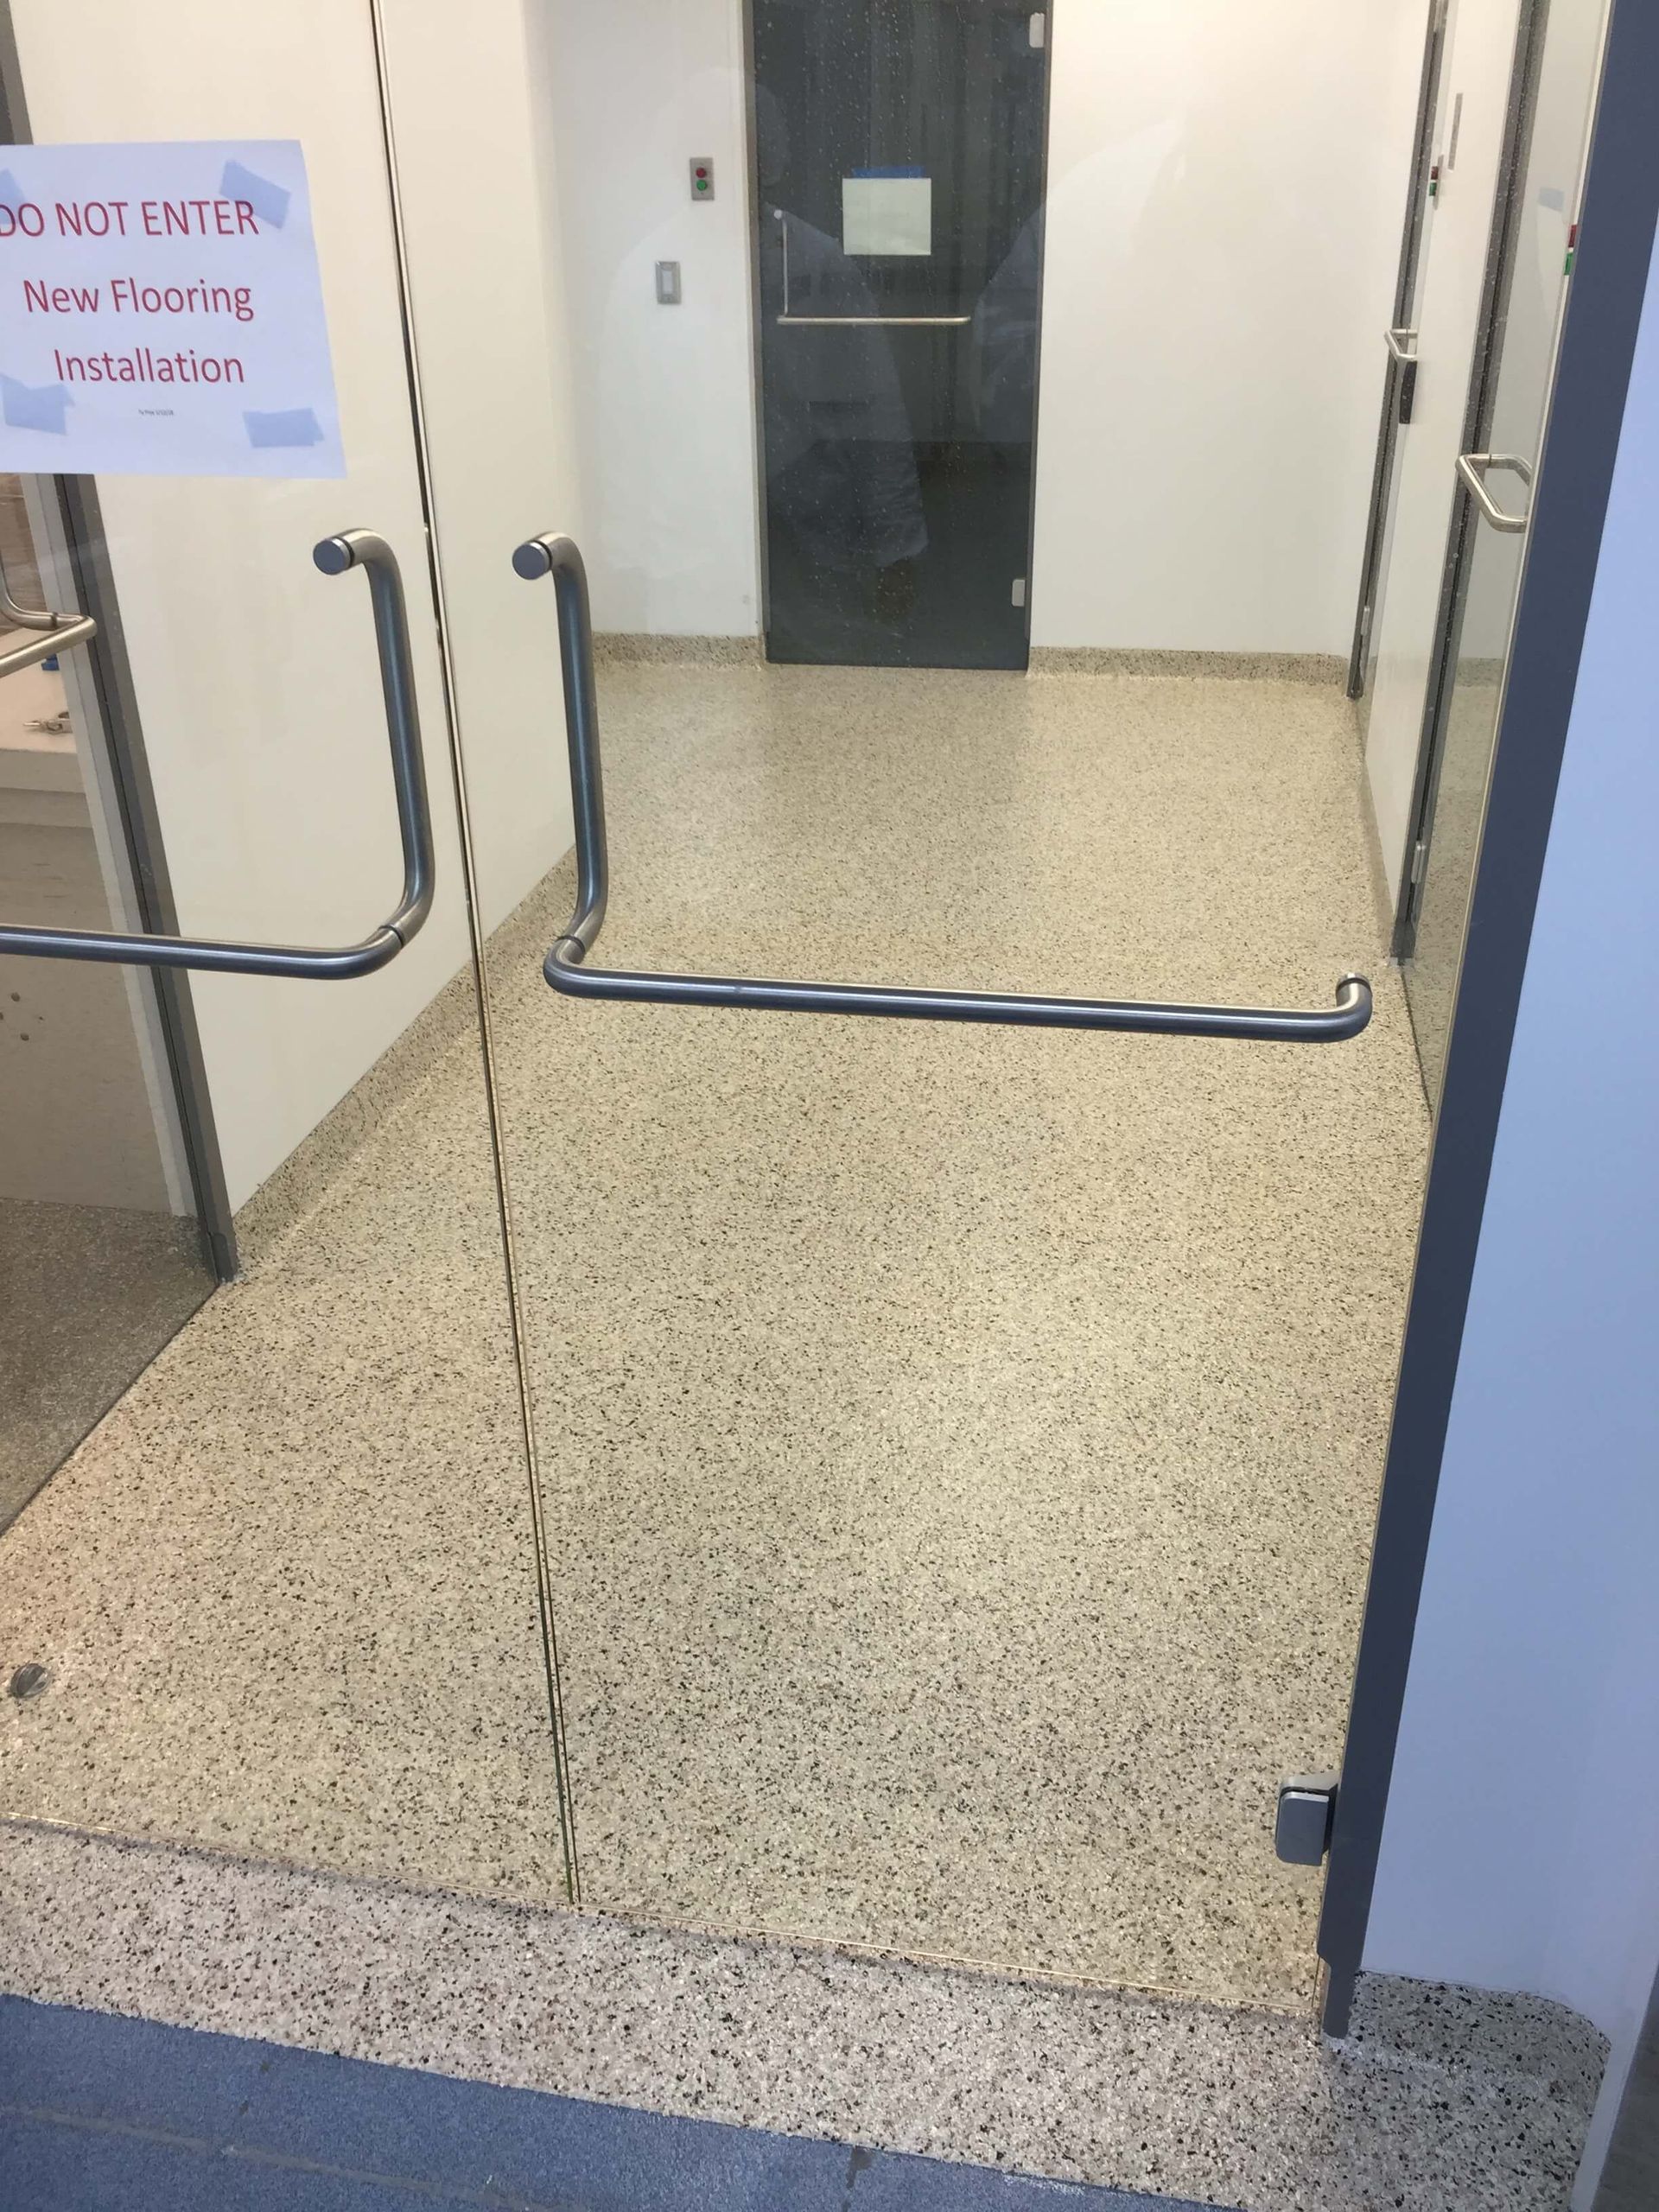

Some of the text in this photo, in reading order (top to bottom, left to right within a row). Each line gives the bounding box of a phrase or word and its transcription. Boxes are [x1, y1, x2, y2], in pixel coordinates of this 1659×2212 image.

[0, 200, 260, 237] DO NOT ENTER
[22, 277, 254, 321] New Flooring
[54, 347, 245, 383] Installation
